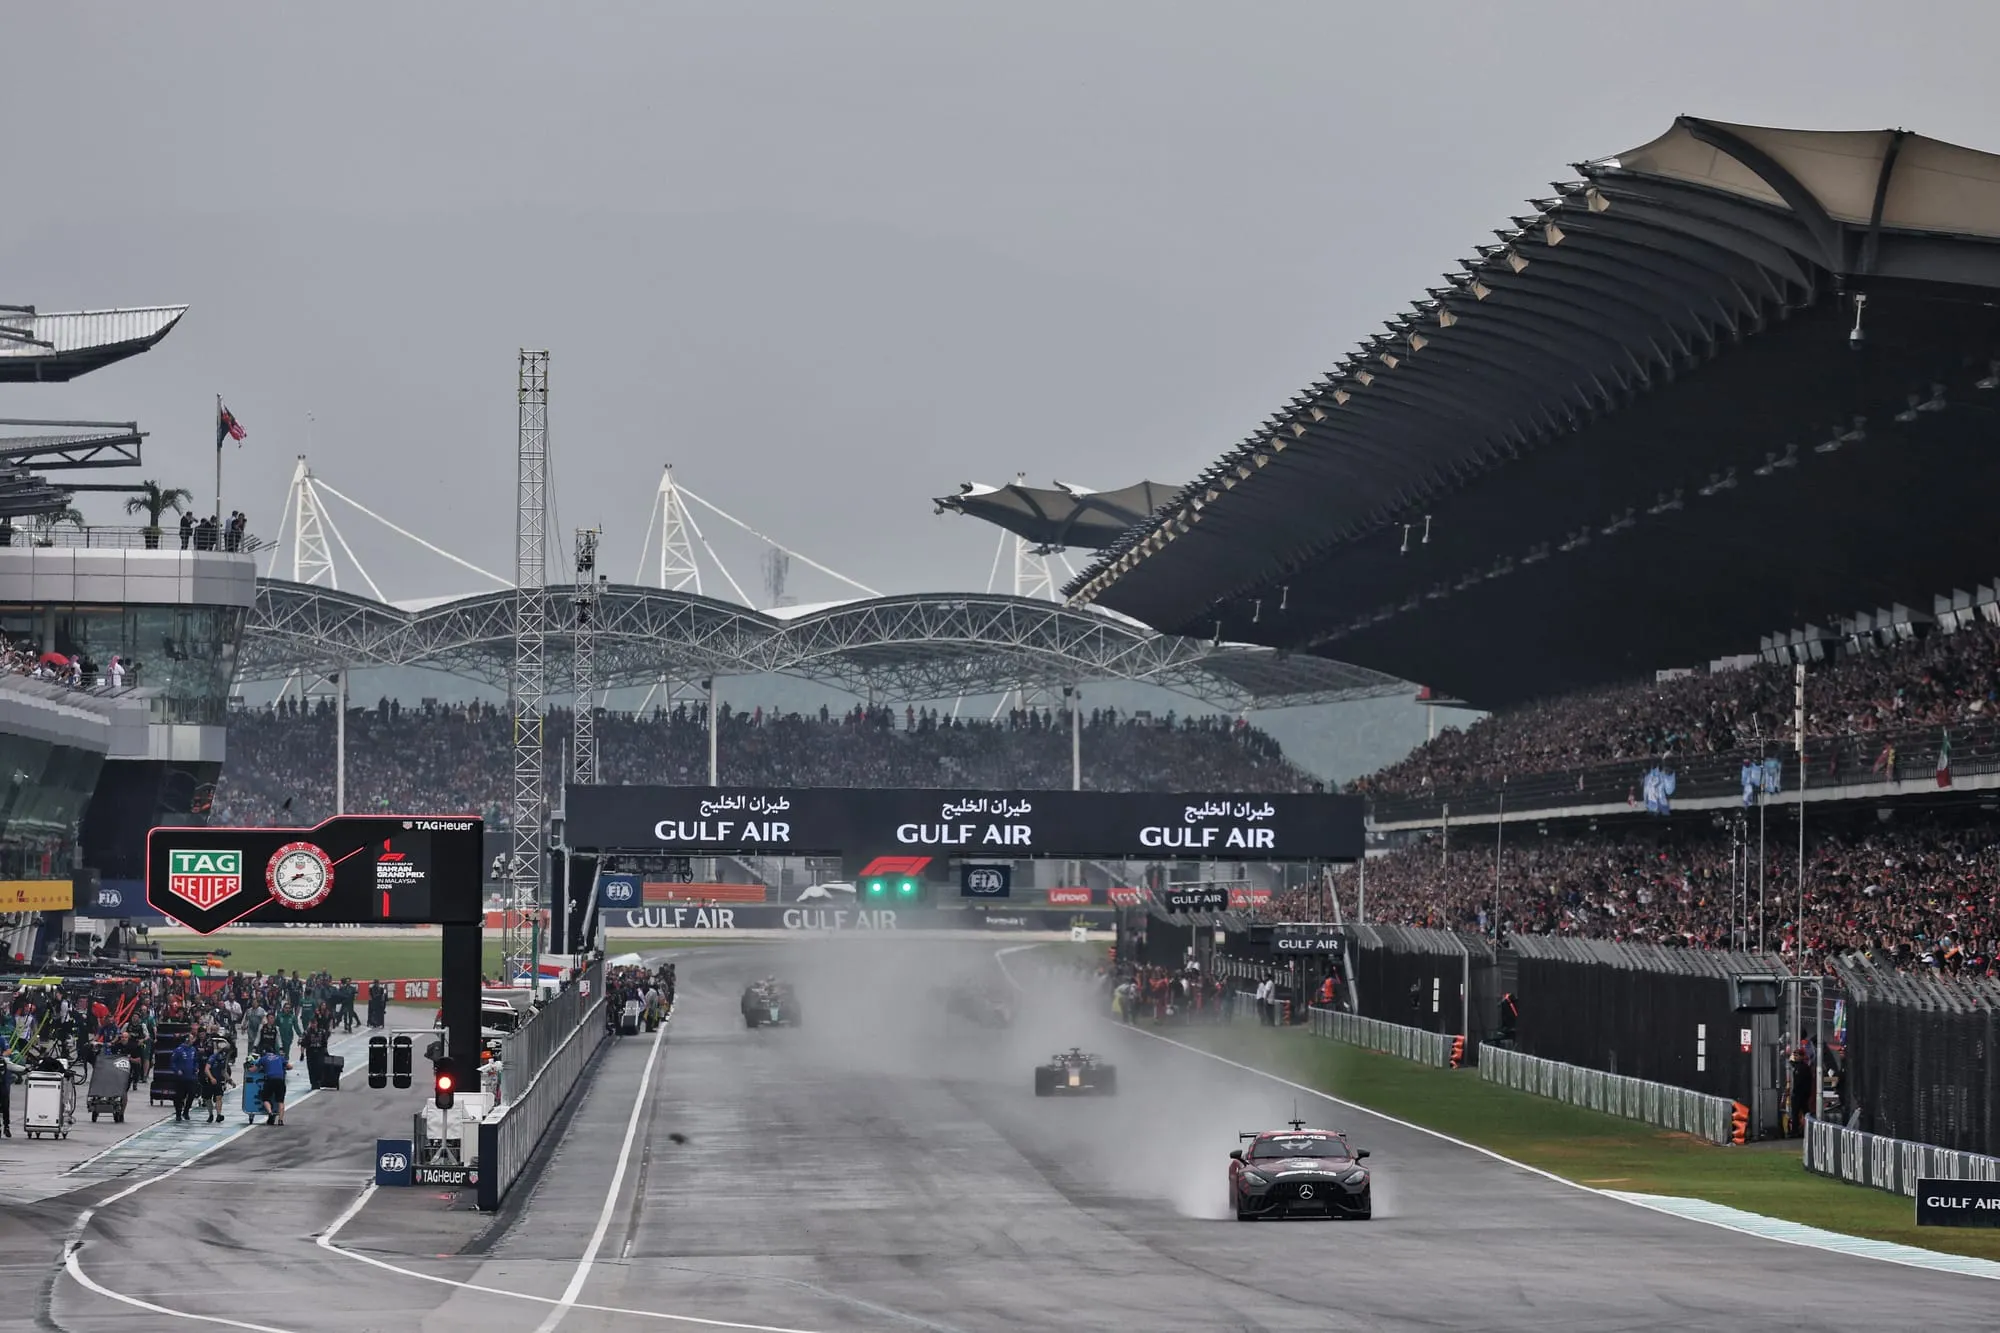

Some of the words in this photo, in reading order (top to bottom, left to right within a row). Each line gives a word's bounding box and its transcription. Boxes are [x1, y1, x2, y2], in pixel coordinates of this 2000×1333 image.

[700, 795, 745, 816] الخليج
[749, 796, 790, 814] طيران
[941, 798, 987, 819] الخليج
[991, 798, 1032, 817] طيران
[1184, 801, 1230, 823] الخليج
[1233, 802, 1275, 821] طيران
[654, 820, 734, 841] GULF
[741, 821, 790, 841] AIR
[896, 824, 976, 844] GULF
[982, 824, 1032, 845] AIR
[1139, 827, 1219, 848] GULF
[1225, 827, 1275, 848] AIR
[175, 855, 235, 872] TAG
[971, 874, 999, 887] FIA
[98, 892, 119, 904] FIA
[174, 877, 238, 905] HEUER
[608, 885, 631, 897] FIA
[1051, 891, 1089, 902] Lenovo
[1172, 895, 1201, 905] GULF
[1203, 894, 1222, 903] AIR
[626, 908, 687, 928] GULF
[694, 908, 734, 929] AIR
[783, 908, 848, 930] GULF
[855, 909, 897, 930] AIR
[1278, 939, 1314, 949] GULF
[1316, 939, 1338, 949] AIR
[381, 1156, 404, 1168] FIA
[1926, 1196, 1972, 1209] GULF
